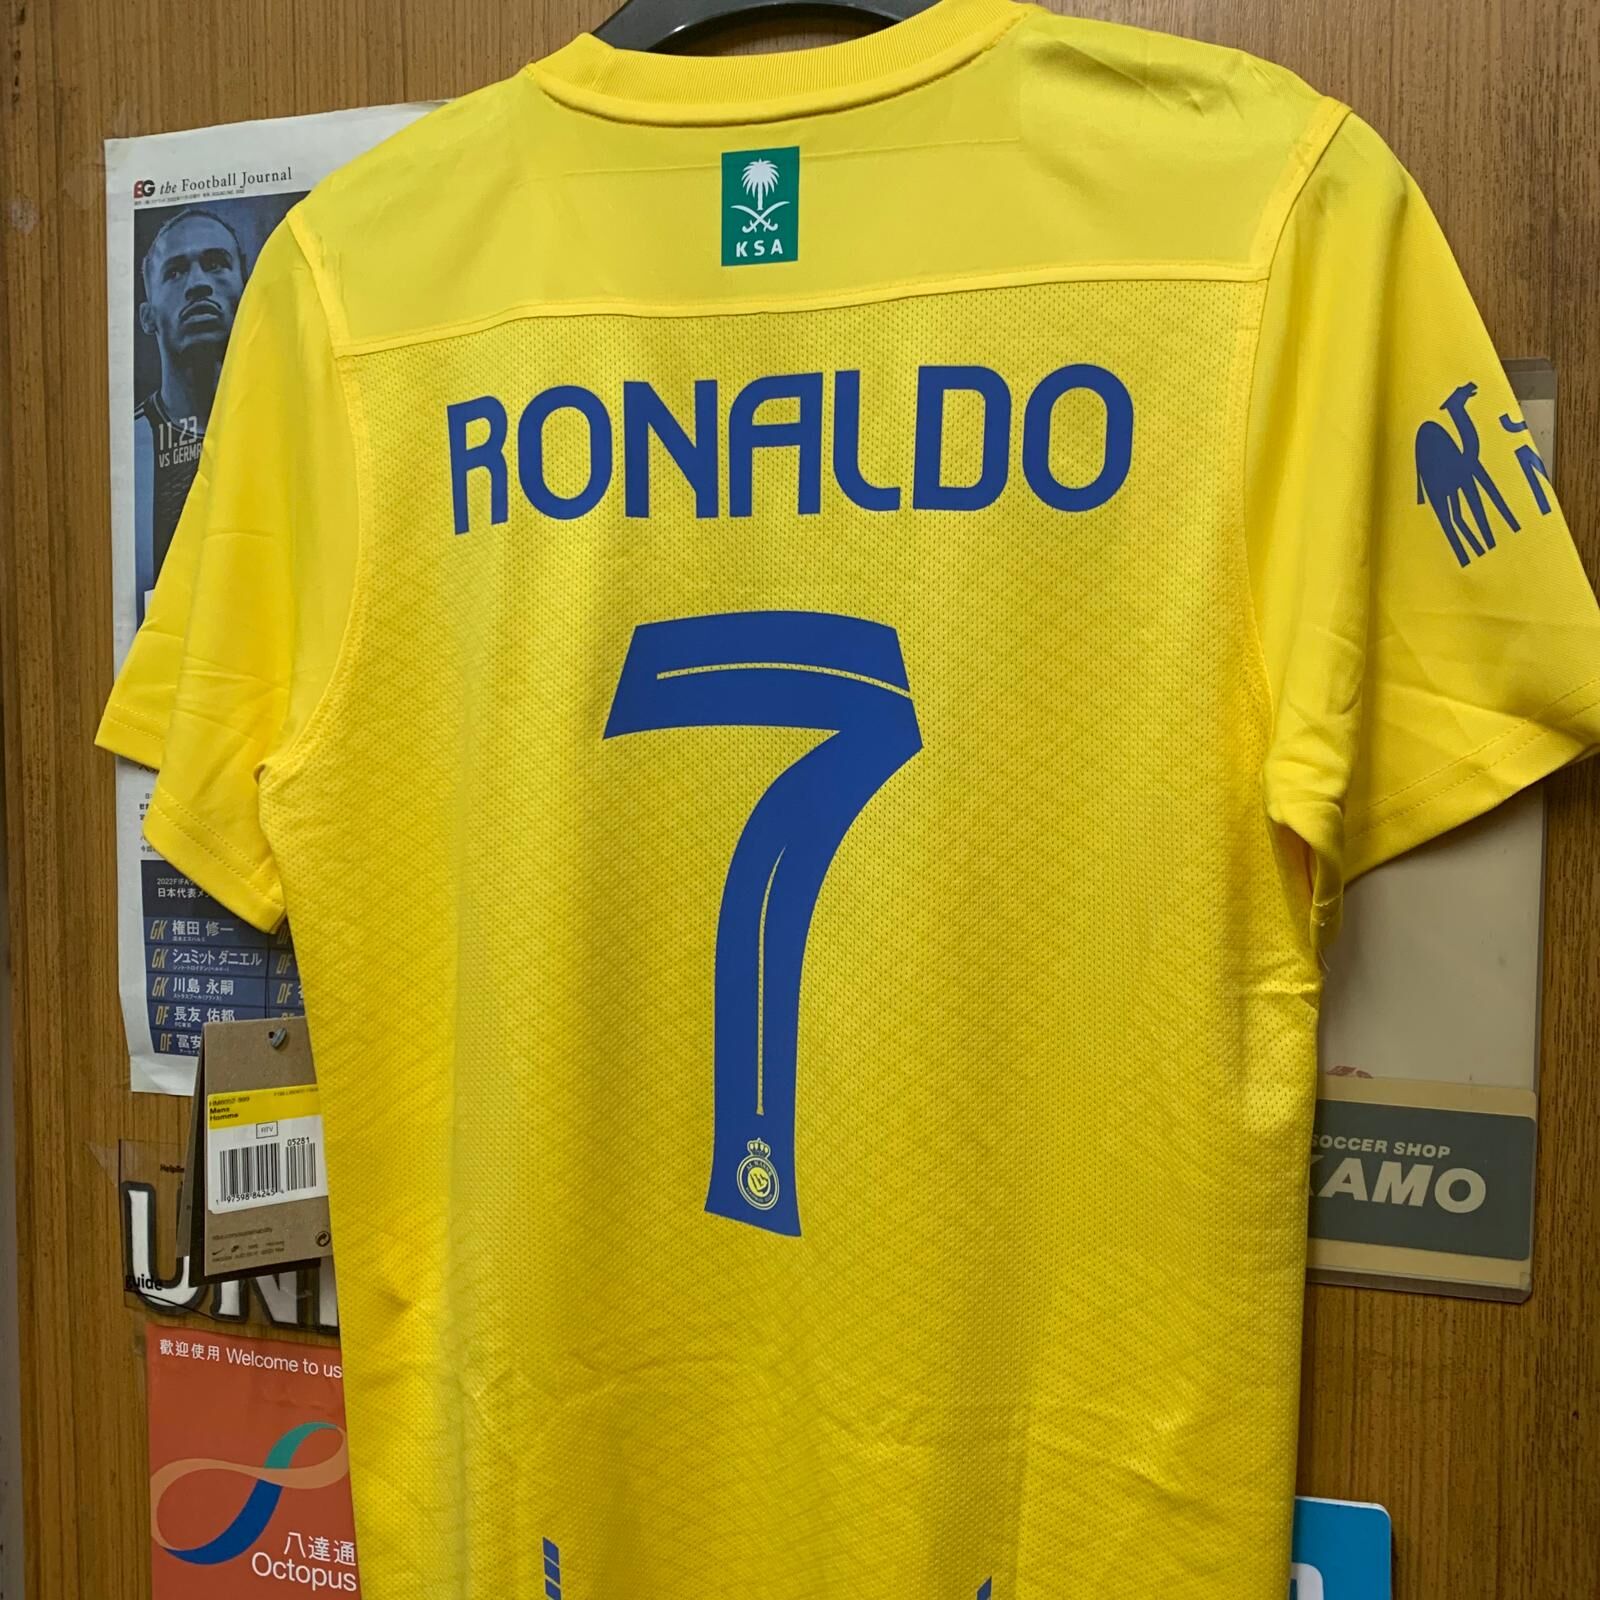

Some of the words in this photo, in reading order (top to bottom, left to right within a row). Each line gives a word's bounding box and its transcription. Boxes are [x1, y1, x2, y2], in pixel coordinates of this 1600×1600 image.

[159, 181, 177, 195] the
[182, 172, 237, 191] Football
[240, 166, 293, 188] Journal
[736, 239, 783, 257] KSA
[159, 416, 198, 451] 11.23
[447, 364, 1134, 535] RONALDO
[158, 452, 170, 468] VS
[150, 920, 167, 940] GK
[172, 920, 200, 935] 権田
[205, 921, 234, 936] 修一
[602, 611, 923, 1237] 7
[152, 948, 169, 968] GK
[172, 948, 216, 965] シュミット
[218, 949, 262, 966] ダニエル
[152, 976, 169, 997] GK
[173, 977, 200, 994] 川島
[276, 983, 294, 1004] DF
[156, 1005, 170, 1025] DF
[174, 1006, 201, 1023] 長友
[160, 1033, 173, 1051] DF
[209, 1113, 239, 1121] Homme
[287, 1137, 310, 1147] 05281
[1393, 1142, 1451, 1159] SHOP
[159, 1339, 220, 1362] 歡迎使用
[226, 1347, 299, 1373] Welcome
[303, 1358, 319, 1375] to
[283, 1531, 356, 1567] 八達通
[252, 1552, 357, 1592] Octopus
